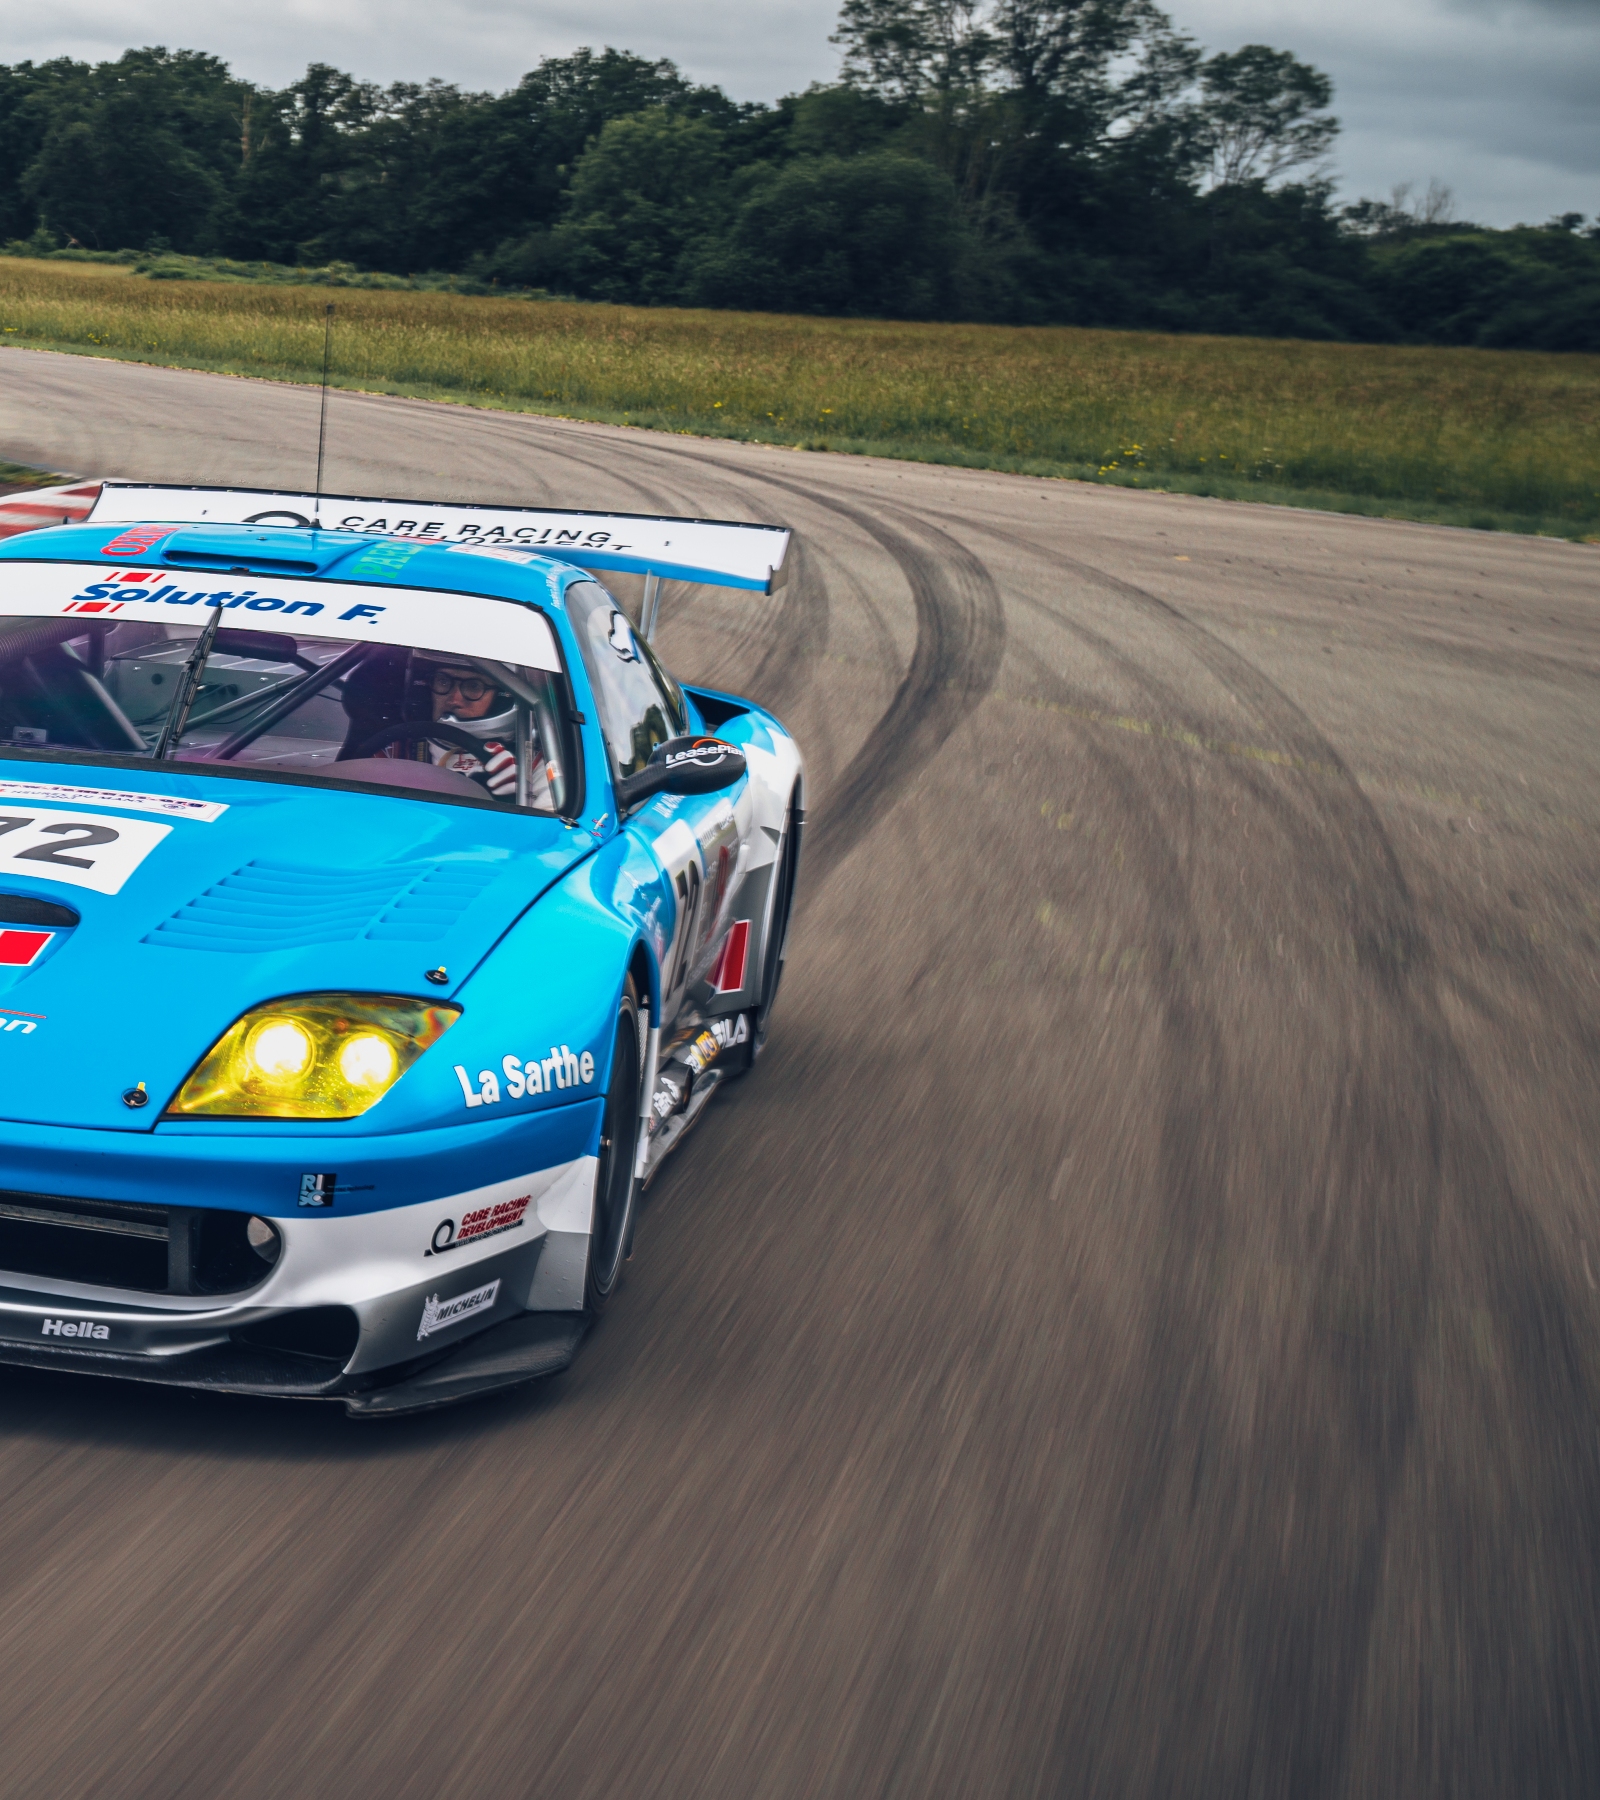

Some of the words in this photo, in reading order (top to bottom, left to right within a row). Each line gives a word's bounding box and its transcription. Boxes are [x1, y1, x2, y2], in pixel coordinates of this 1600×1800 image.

[340, 515, 444, 536] CARE
[457, 523, 611, 543] RACING
[71, 583, 325, 615] Solution
[337, 603, 386, 625] F.
[453, 1064, 500, 1108] La
[502, 1044, 595, 1099] Sarthe
[456, 1208, 526, 1239] DEVELOPMENT
[461, 1206, 492, 1227] CARE
[490, 1194, 532, 1217] RACING
[436, 1286, 495, 1321] MICHELIN
[41, 1318, 110, 1340] Hella
